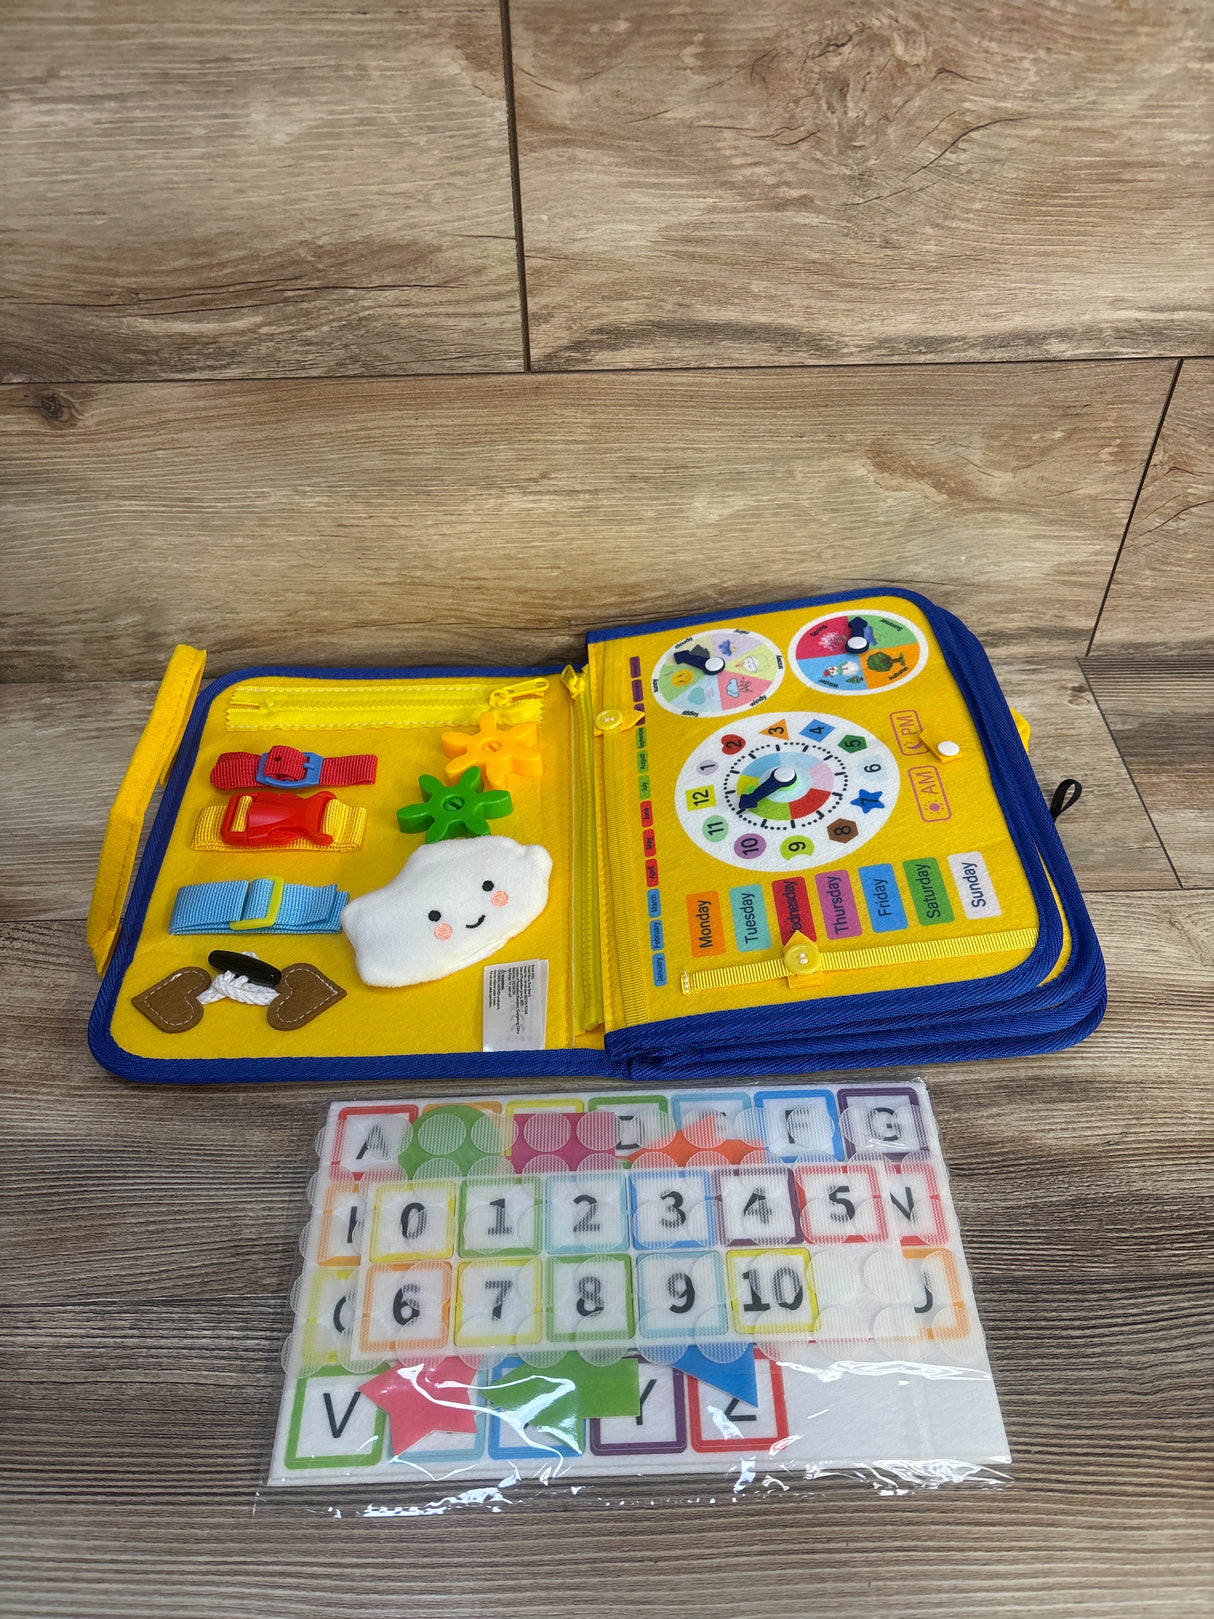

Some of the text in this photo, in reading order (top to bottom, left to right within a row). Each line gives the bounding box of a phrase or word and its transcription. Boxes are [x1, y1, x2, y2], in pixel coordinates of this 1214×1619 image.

[768, 726, 785, 735] 3
[809, 726, 825, 735] 4
[899, 715, 918, 736] PM
[725, 739, 742, 749] 2
[845, 739, 861, 749] 5
[700, 763, 716, 771] 1
[864, 763, 882, 773] 6
[918, 771, 939, 795] AM
[692, 789, 709, 806] 12
[861, 798, 879, 807] 7
[707, 821, 725, 836] 11
[834, 825, 852, 836] 8
[741, 837, 759, 855] 10
[788, 841, 806, 852] 9
[915, 864, 941, 919] Saturday
[961, 862, 986, 908] Sunday
[782, 880, 802, 933] ednesday
[826, 876, 849, 935] Thursday
[873, 878, 893, 917] Friday
[696, 900, 713, 949] Monday
[739, 892, 758, 944] Tuesday
[653, 922, 661, 949] February
[656, 957, 664, 982] January
[867, 1107, 903, 1142] G
[355, 1123, 389, 1160] A
[401, 1202, 427, 1240] 0
[487, 1198, 512, 1236] 1
[573, 1194, 600, 1233] 2
[660, 1191, 686, 1228] 3
[744, 1187, 772, 1225] 4
[828, 1185, 855, 1221] 5
[392, 1283, 421, 1326] 6
[484, 1280, 513, 1321] 7
[576, 1275, 604, 1317] 8
[666, 1272, 695, 1314] 9
[742, 1266, 804, 1312] 10
[323, 1391, 362, 1438] V
